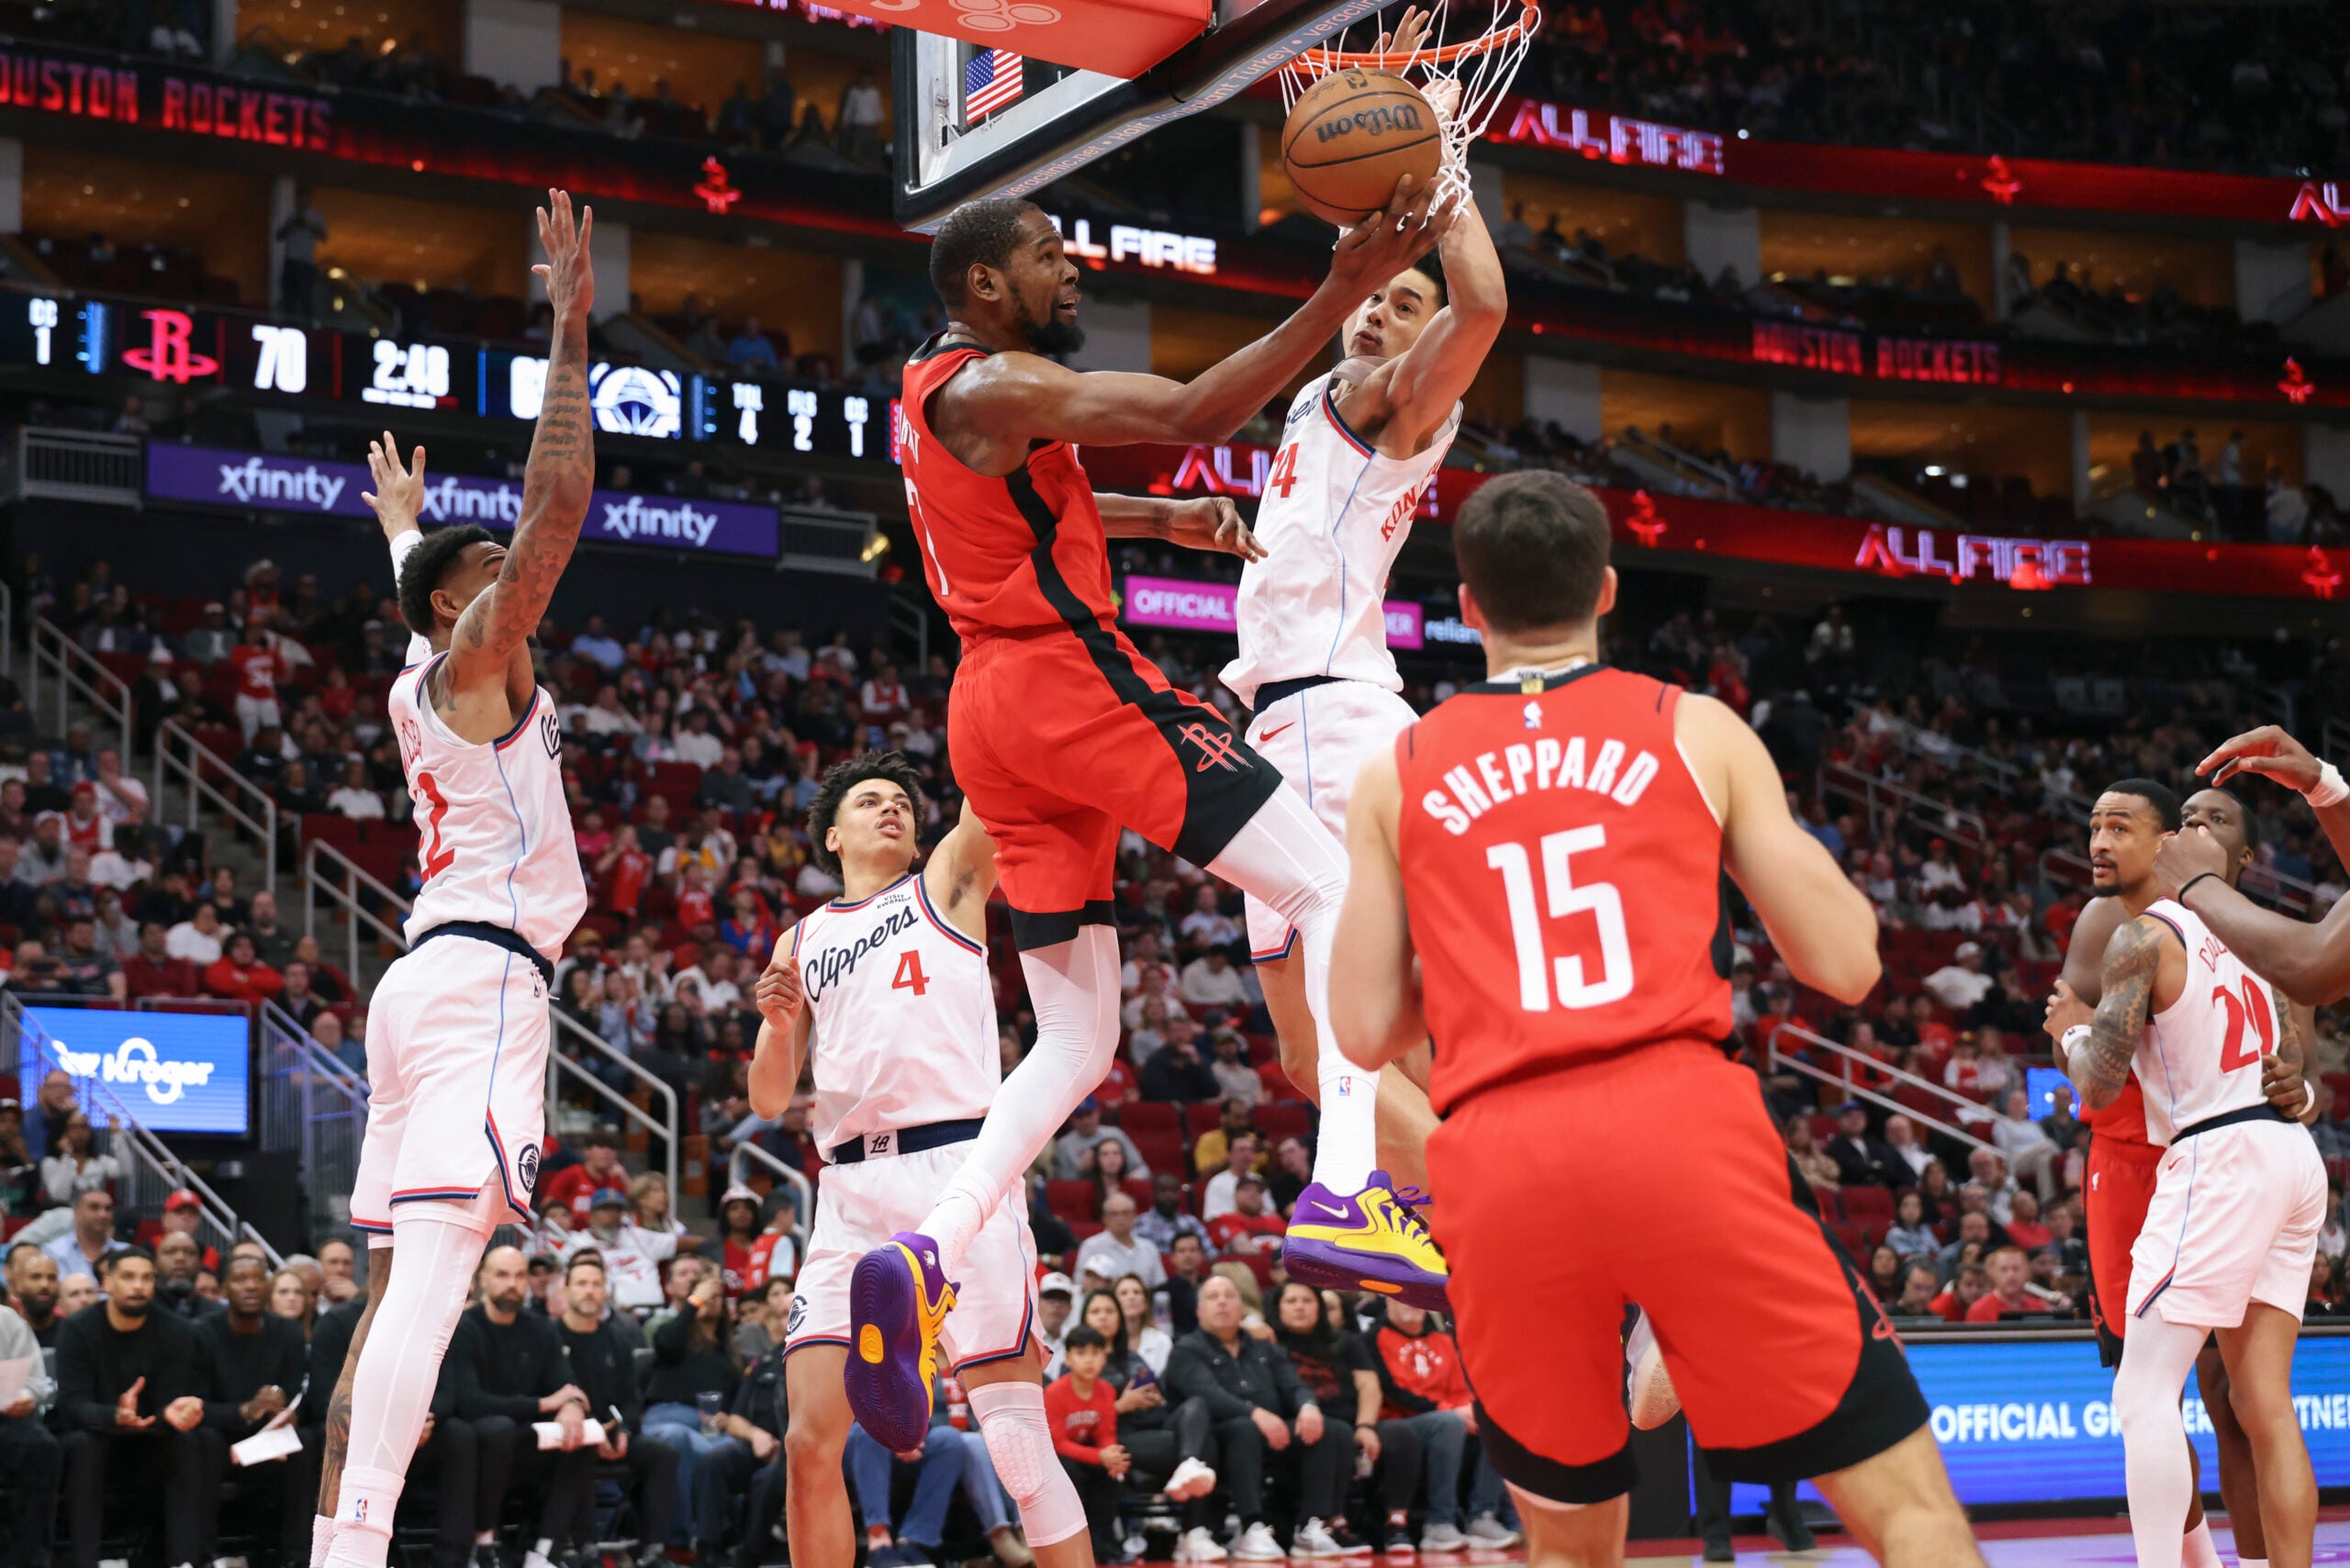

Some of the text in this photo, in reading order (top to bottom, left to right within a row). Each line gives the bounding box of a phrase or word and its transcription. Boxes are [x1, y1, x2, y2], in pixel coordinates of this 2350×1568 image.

[1304, 0, 1382, 37] veraclin
[162, 76, 331, 151] ROCKETS
[1000, 45, 1298, 198] veraclinic.net Hair Transplant Turkey
[1315, 102, 1422, 143] Wilson
[1111, 224, 1217, 275] FIRE
[218, 457, 346, 510] xfinity
[602, 496, 718, 547] xfinity
[1855, 522, 1953, 578] ALL
[1134, 588, 1233, 622] OFFICIAL
[1424, 616, 1481, 645] relian
[1423, 737, 1660, 835] SHEPPARD
[1485, 823, 1634, 1012] 15
[805, 905, 919, 1003] Clippers
[891, 949, 930, 996] 4
[2211, 973, 2275, 1075] 20
[102, 1037, 215, 1104] Kroger
[1930, 1401, 2077, 1444] OFFICIAL
